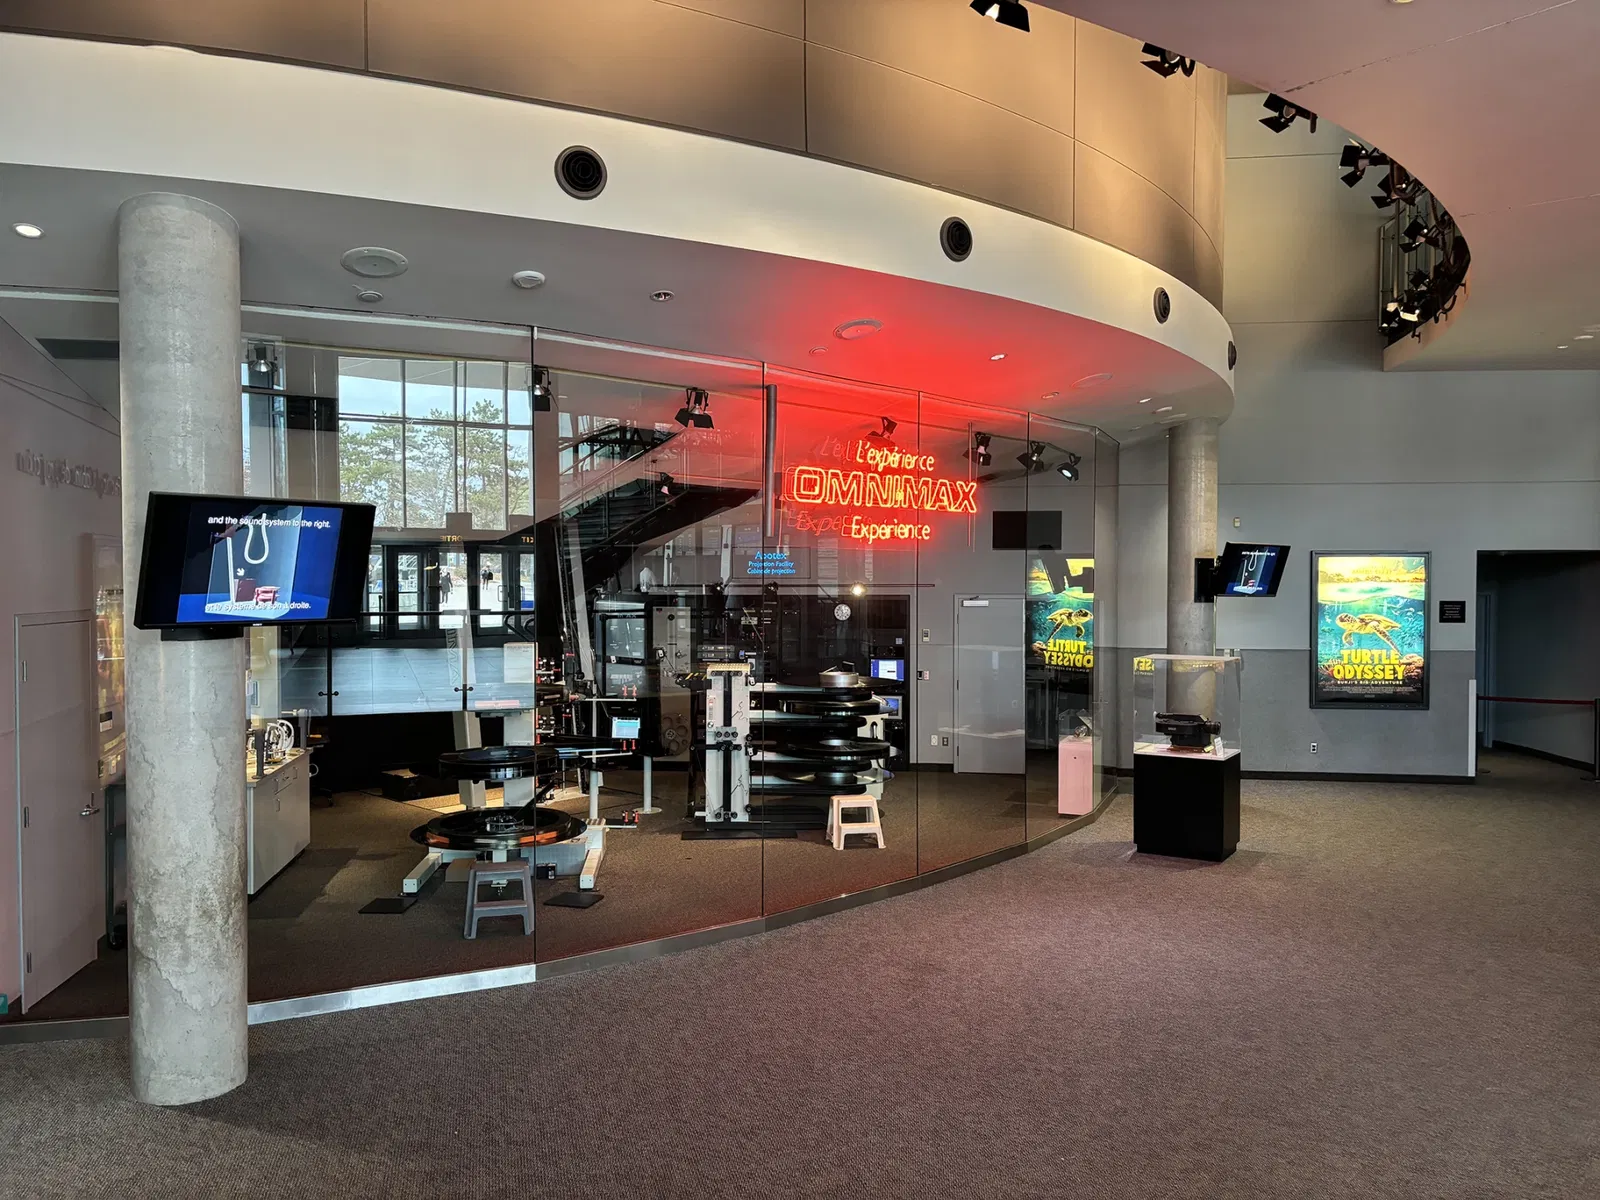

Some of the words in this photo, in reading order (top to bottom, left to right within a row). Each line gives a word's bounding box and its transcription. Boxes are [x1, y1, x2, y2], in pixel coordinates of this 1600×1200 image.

[794, 466, 977, 513] OMNIMAX
[208, 516, 223, 524] and
[225, 516, 237, 525] the
[240, 516, 263, 525] sound
[264, 518, 291, 527] system
[292, 519, 300, 527] to
[301, 519, 312, 527] the
[314, 520, 331, 530] right.
[1340, 649, 1399, 664] TURTLE
[1333, 664, 1406, 680] ODYSSEY
